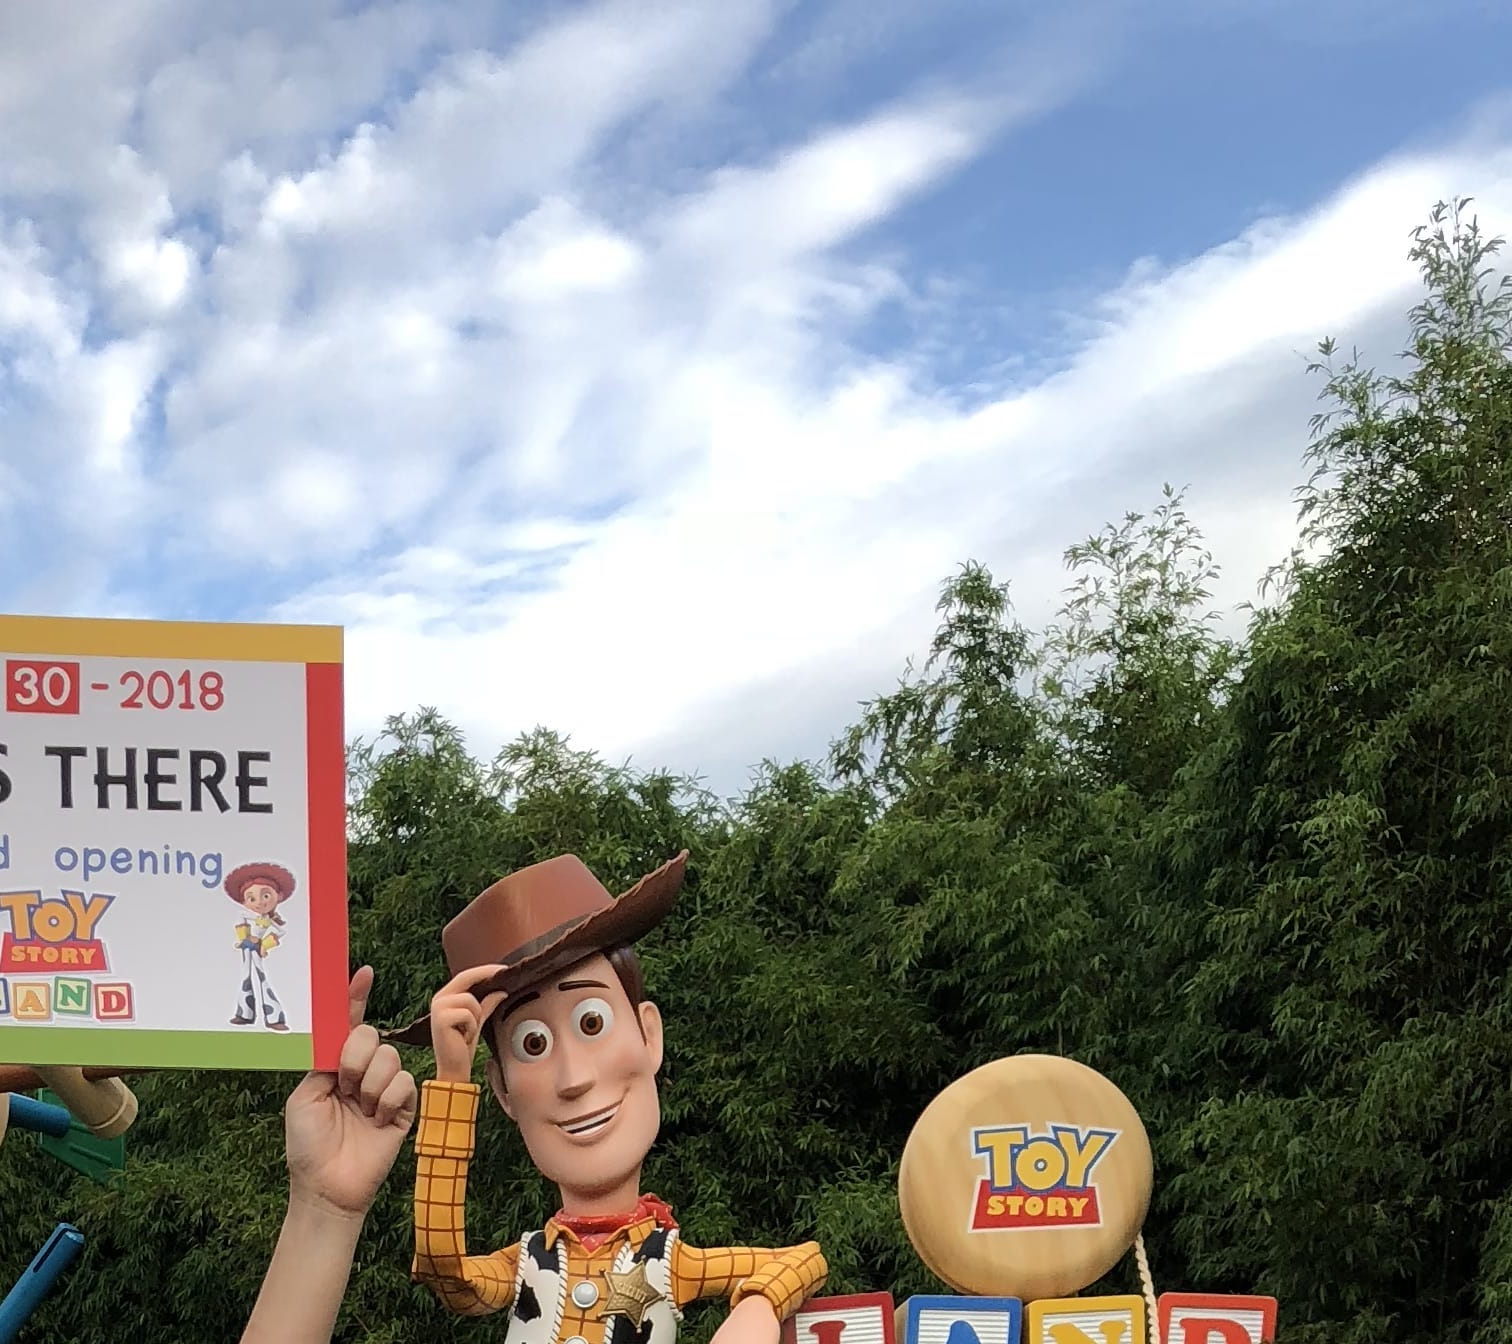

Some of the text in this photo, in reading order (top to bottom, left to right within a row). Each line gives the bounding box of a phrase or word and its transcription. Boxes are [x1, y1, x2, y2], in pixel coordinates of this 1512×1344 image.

[14, 666, 72, 706] 30
[44, 745, 274, 814] THERE
[54, 844, 223, 889] opening
[11, 945, 97, 965] STORY
[974, 1125, 1118, 1195] TOY
[986, 1195, 1090, 1218] STORY
